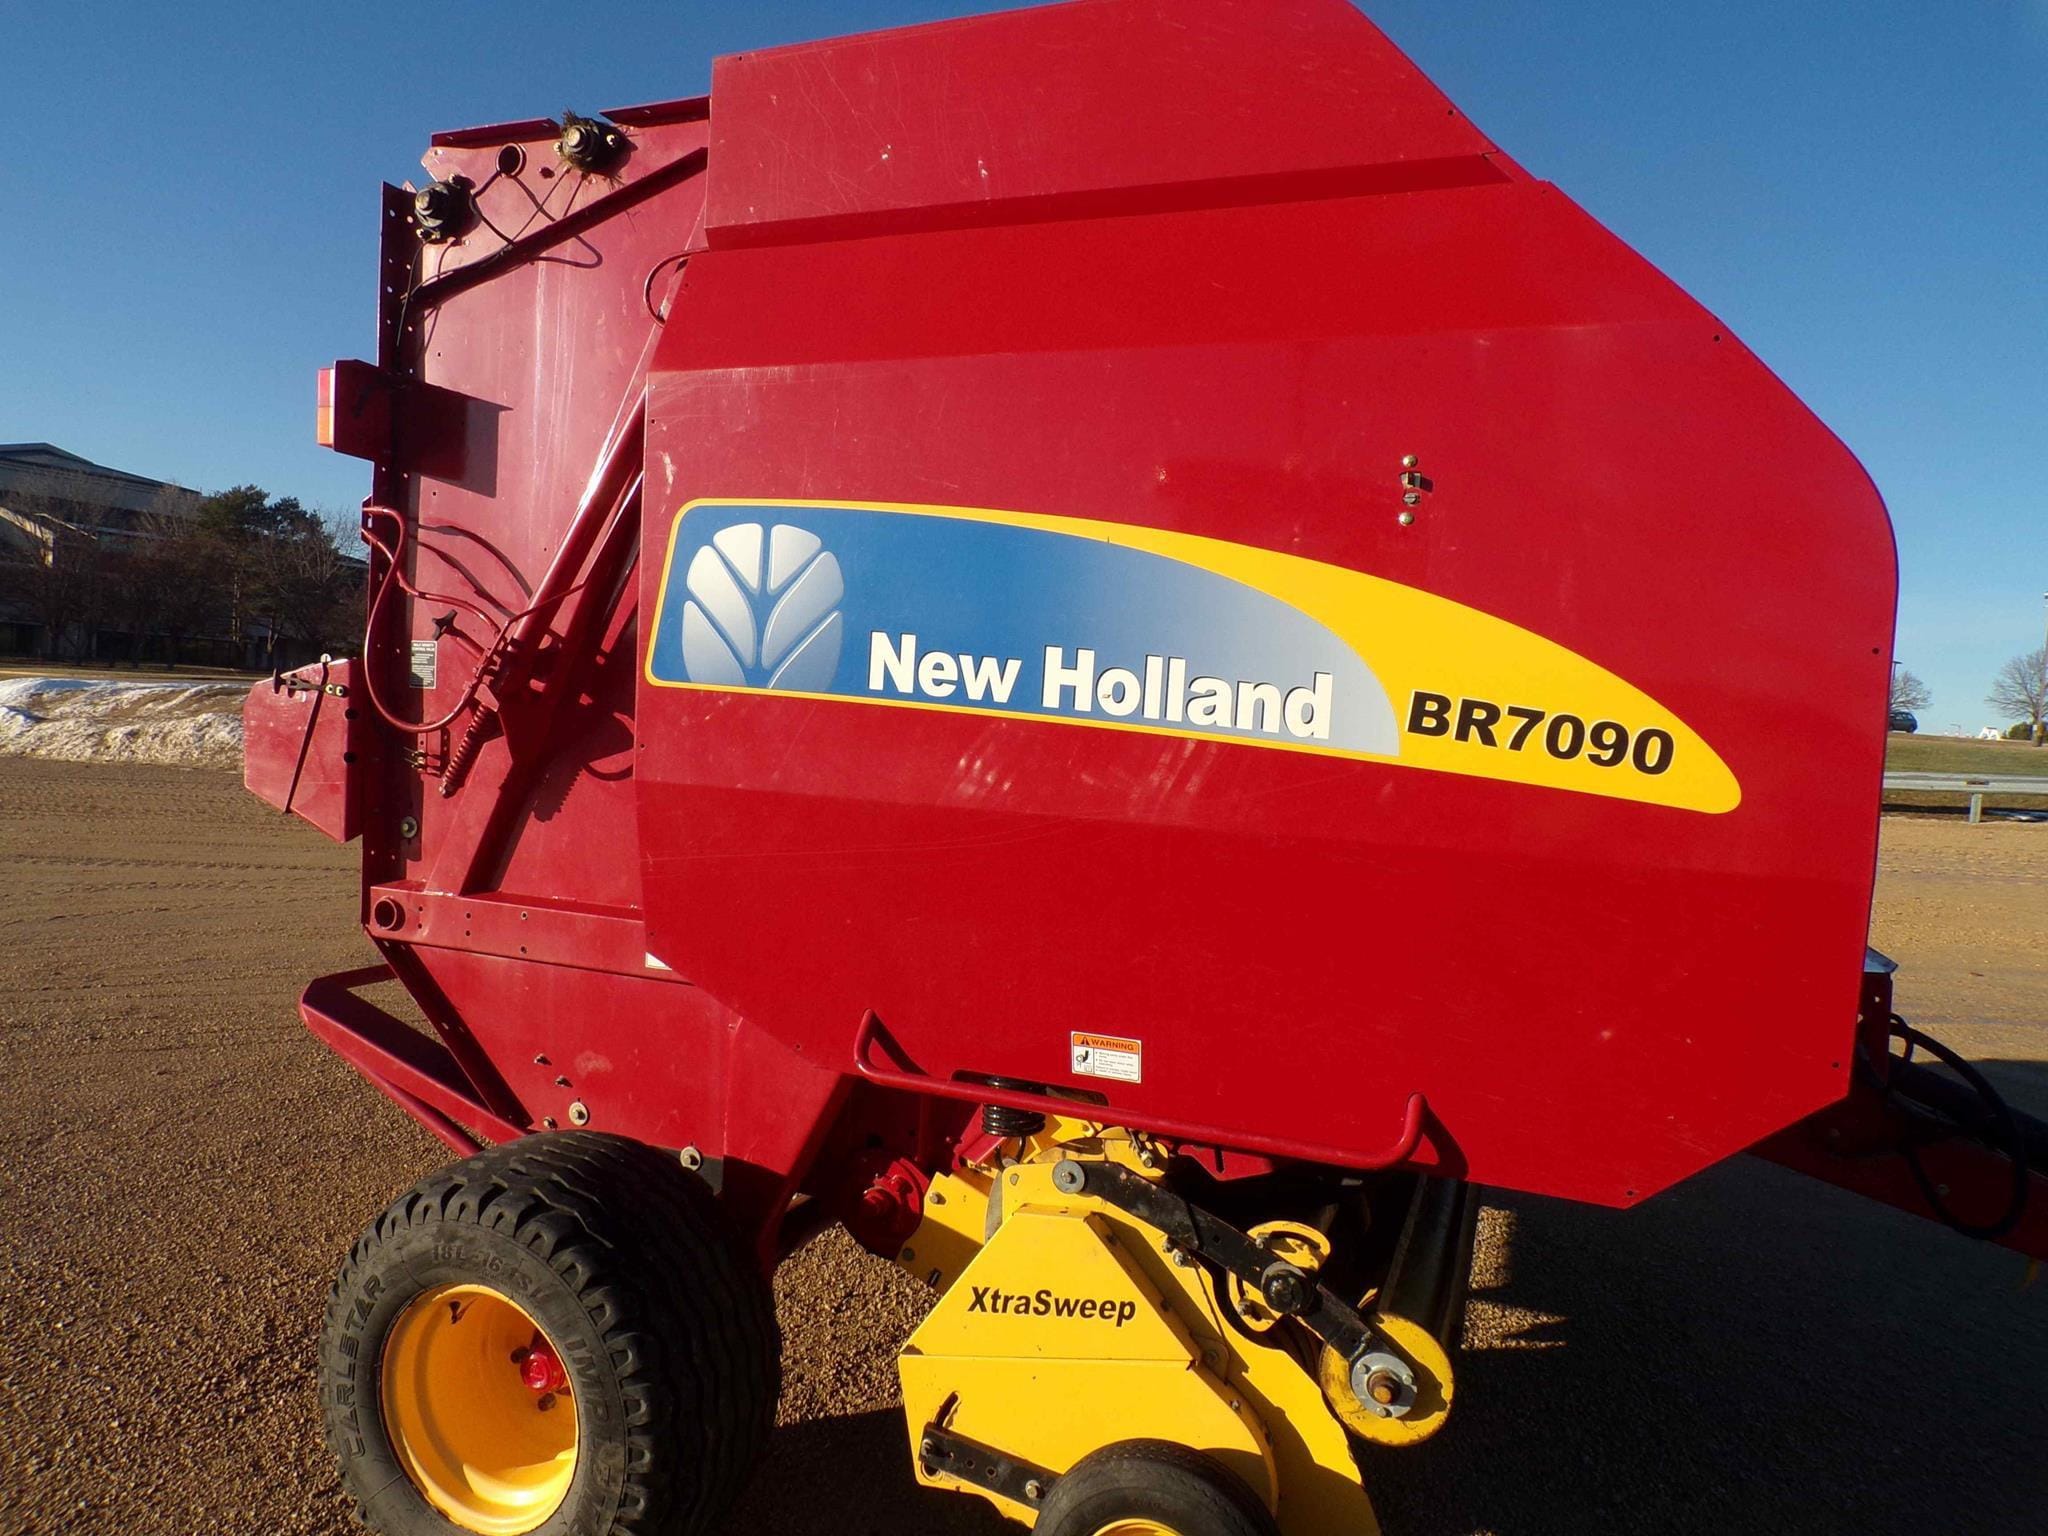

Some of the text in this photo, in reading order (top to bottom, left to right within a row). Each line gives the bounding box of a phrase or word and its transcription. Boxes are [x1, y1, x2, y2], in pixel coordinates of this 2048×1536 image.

[868, 631, 1334, 740] New Holland
[1406, 690, 1675, 776] BR7090
[1090, 1038, 1134, 1051] WARNING
[967, 1286, 1137, 1328] XtraSweep
[336, 1273, 386, 1458] CARLSTAR
